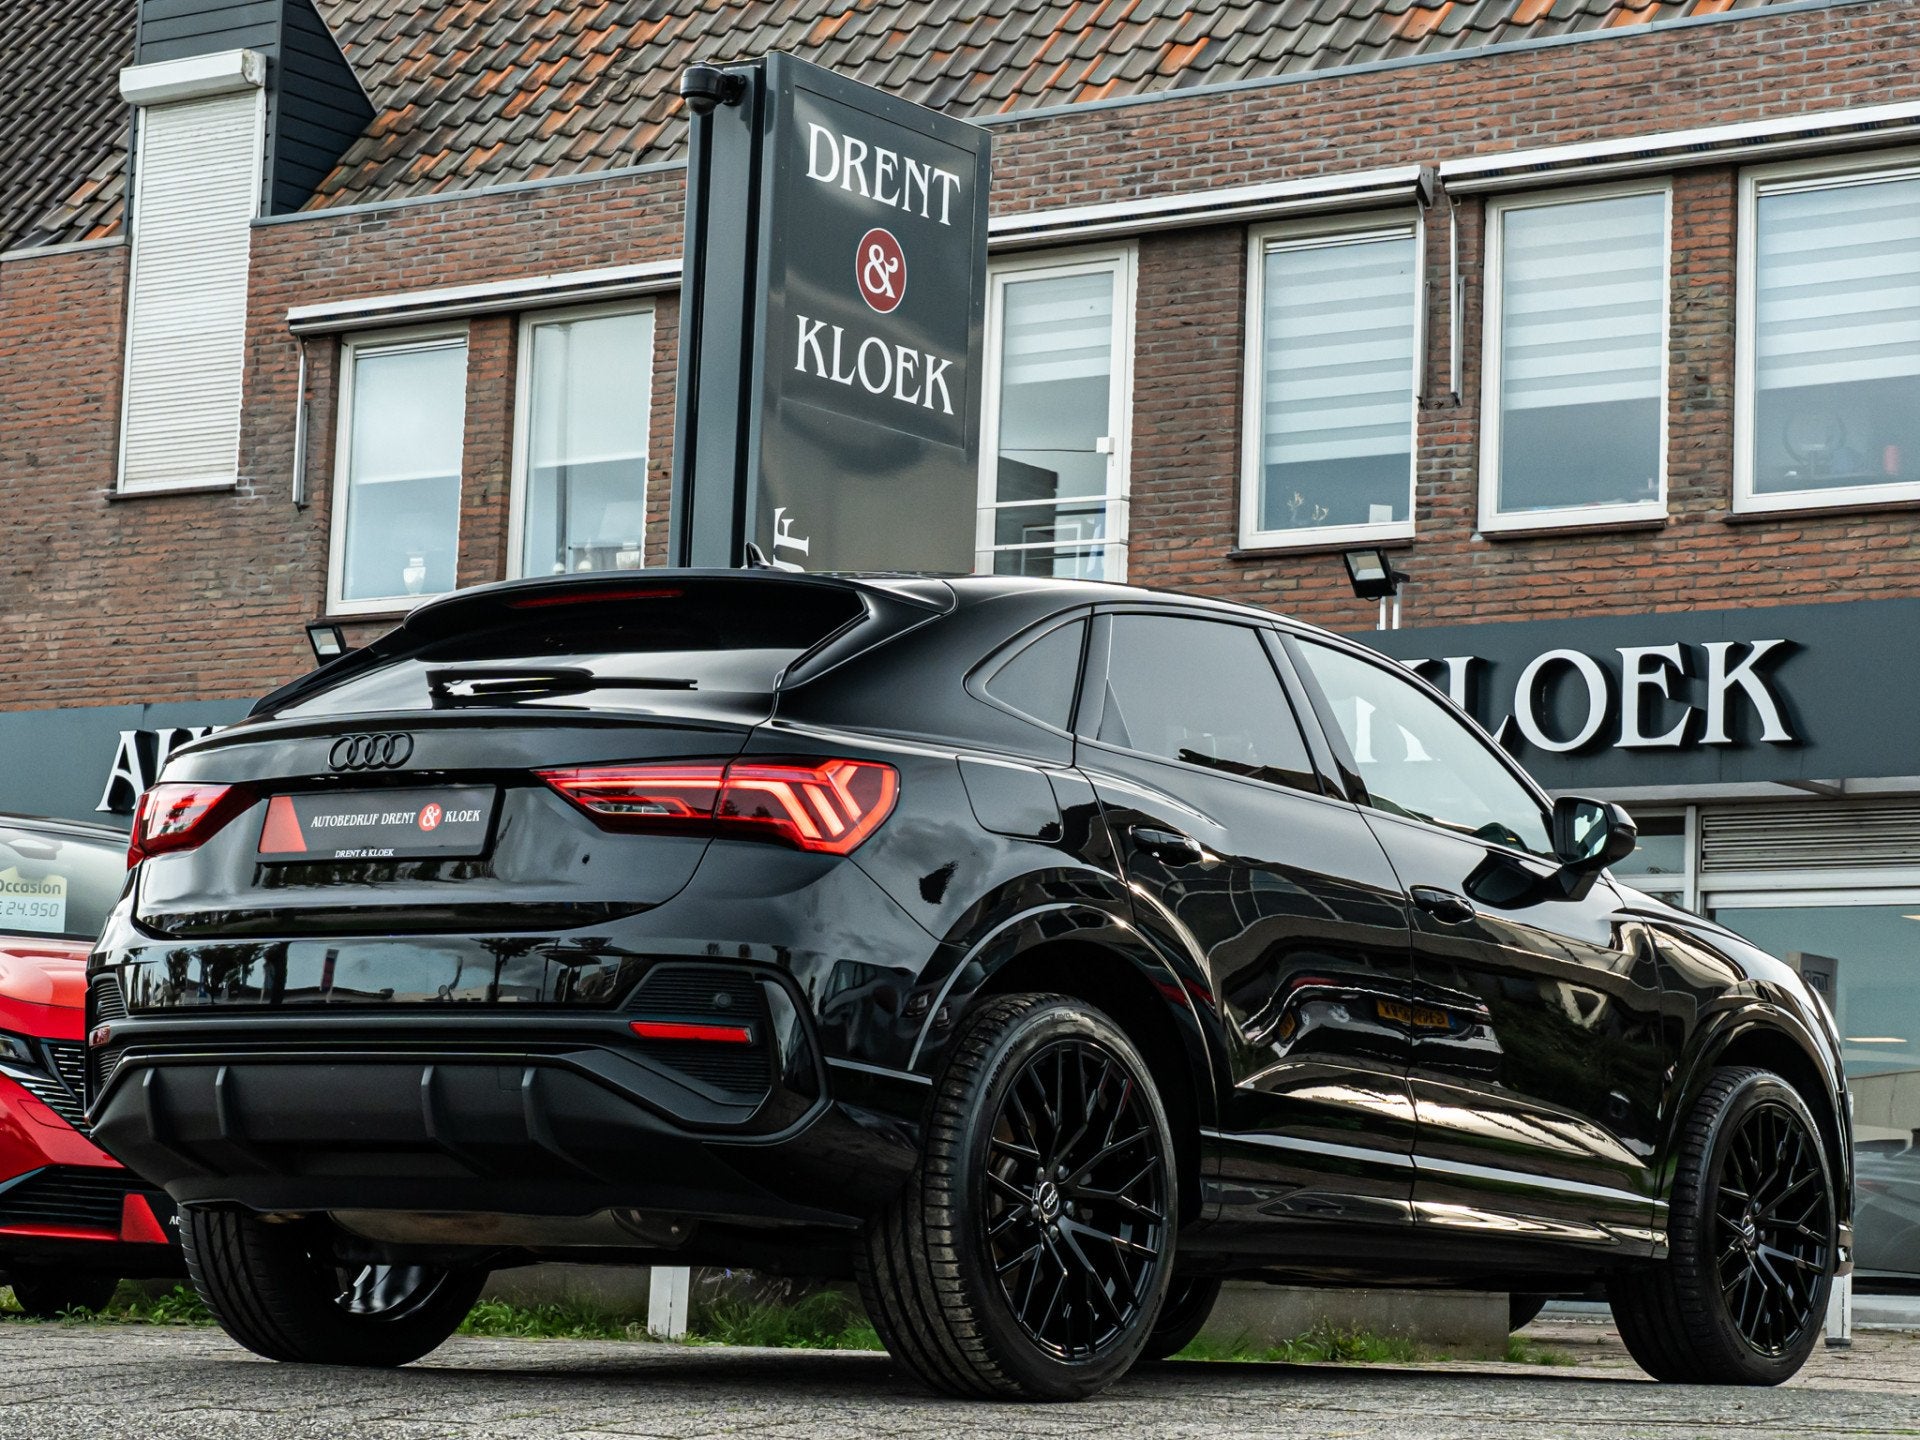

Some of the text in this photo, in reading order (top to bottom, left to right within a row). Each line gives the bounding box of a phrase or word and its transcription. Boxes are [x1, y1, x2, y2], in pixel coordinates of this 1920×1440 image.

[806, 122, 961, 226] DRENT
[864, 244, 899, 299] &
[794, 314, 954, 415] KLOEK
[311, 805, 482, 828] AUTOBEDRIJF DRENT & KLOEK
[334, 849, 361, 858] DRENT
[367, 848, 395, 857] KLOEK
